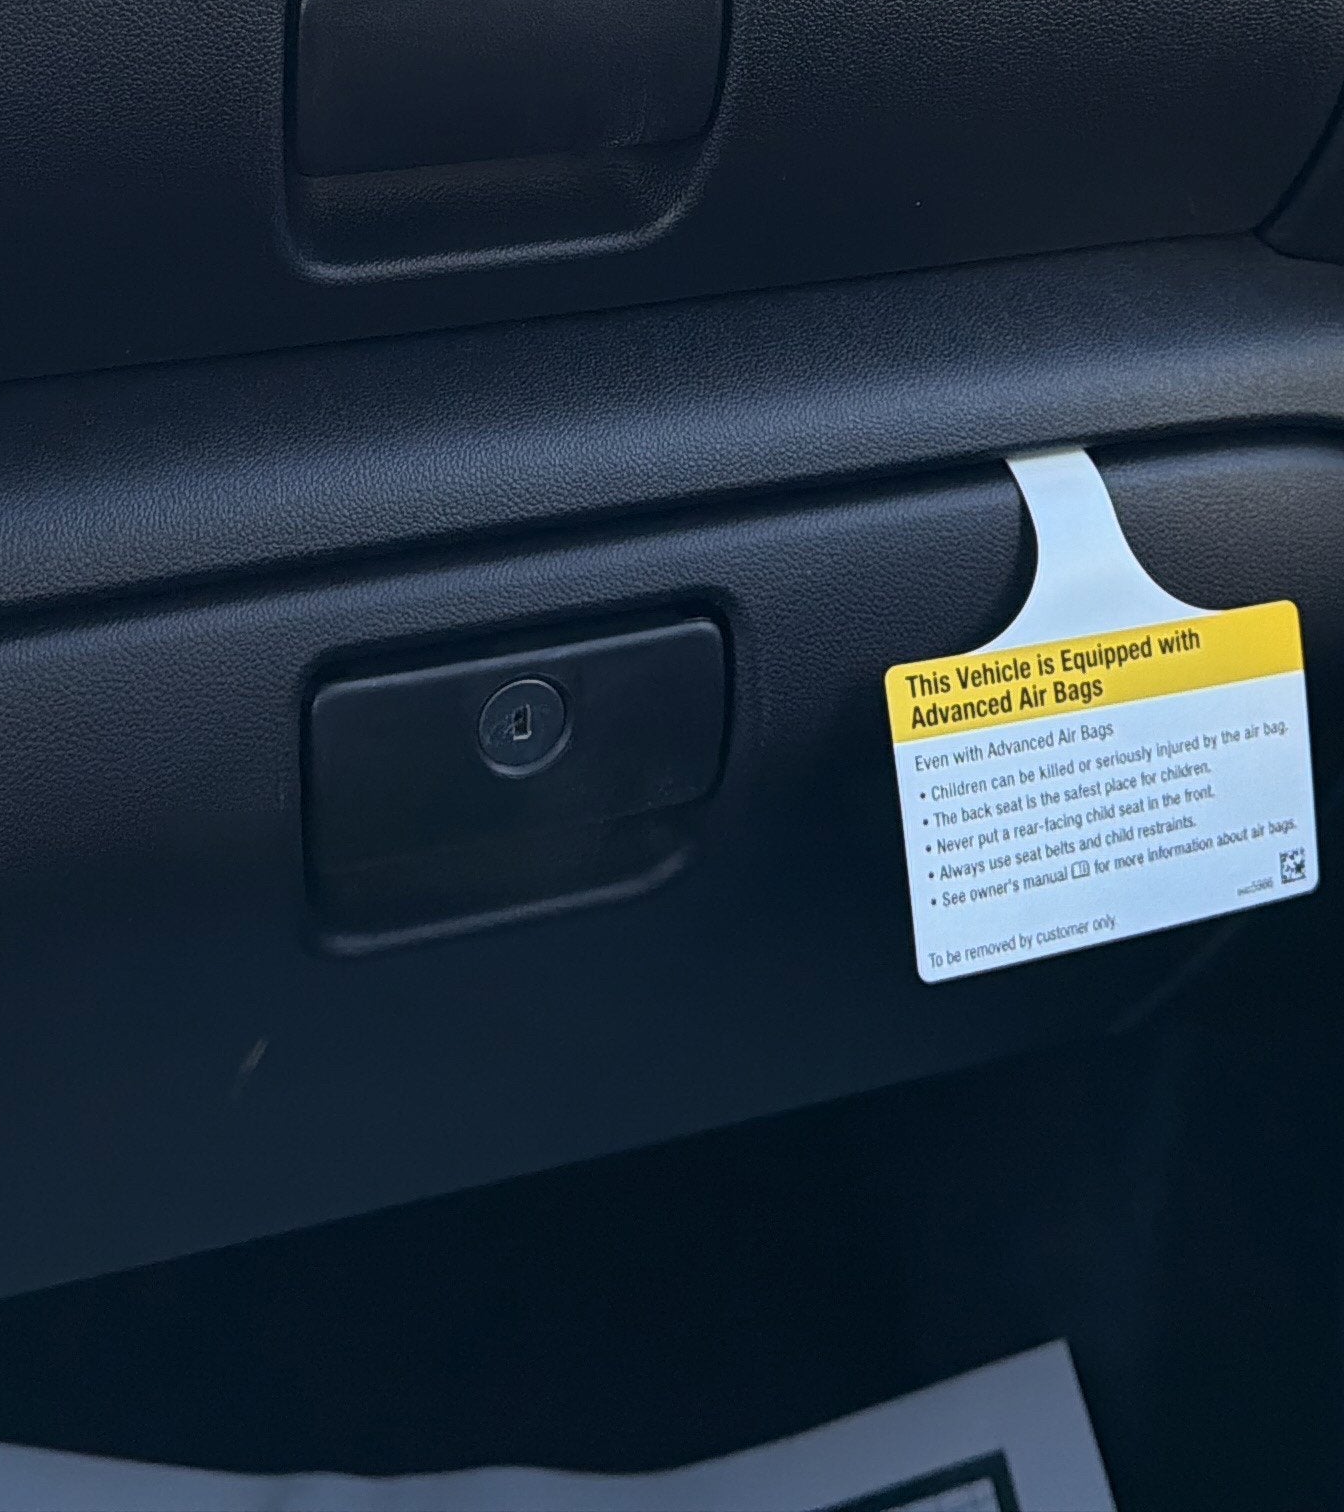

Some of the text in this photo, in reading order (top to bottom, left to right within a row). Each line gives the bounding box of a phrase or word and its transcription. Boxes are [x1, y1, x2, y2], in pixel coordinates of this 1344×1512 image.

[905, 628, 1200, 698] This Vehicle is Equipped with
[912, 679, 1103, 729] Advanced Air Bags
[915, 722, 1114, 771] Even with Advanced Air Bags
[931, 721, 1288, 801] Children can be killed or seriously injured by the air bag.
[933, 762, 1212, 828] The back seat is the safest place for children.
[937, 784, 1215, 853] Never put a rear-facing child seat in the front.
[940, 815, 1197, 880] Always use seat belts and child restraints.
[942, 818, 1297, 907] See owner's manual for more information about air bags.
[928, 952, 943, 968] To
[946, 950, 961, 965] be
[965, 935, 1016, 960] removed
[1019, 933, 1033, 948] by
[1036, 921, 1089, 945] customer
